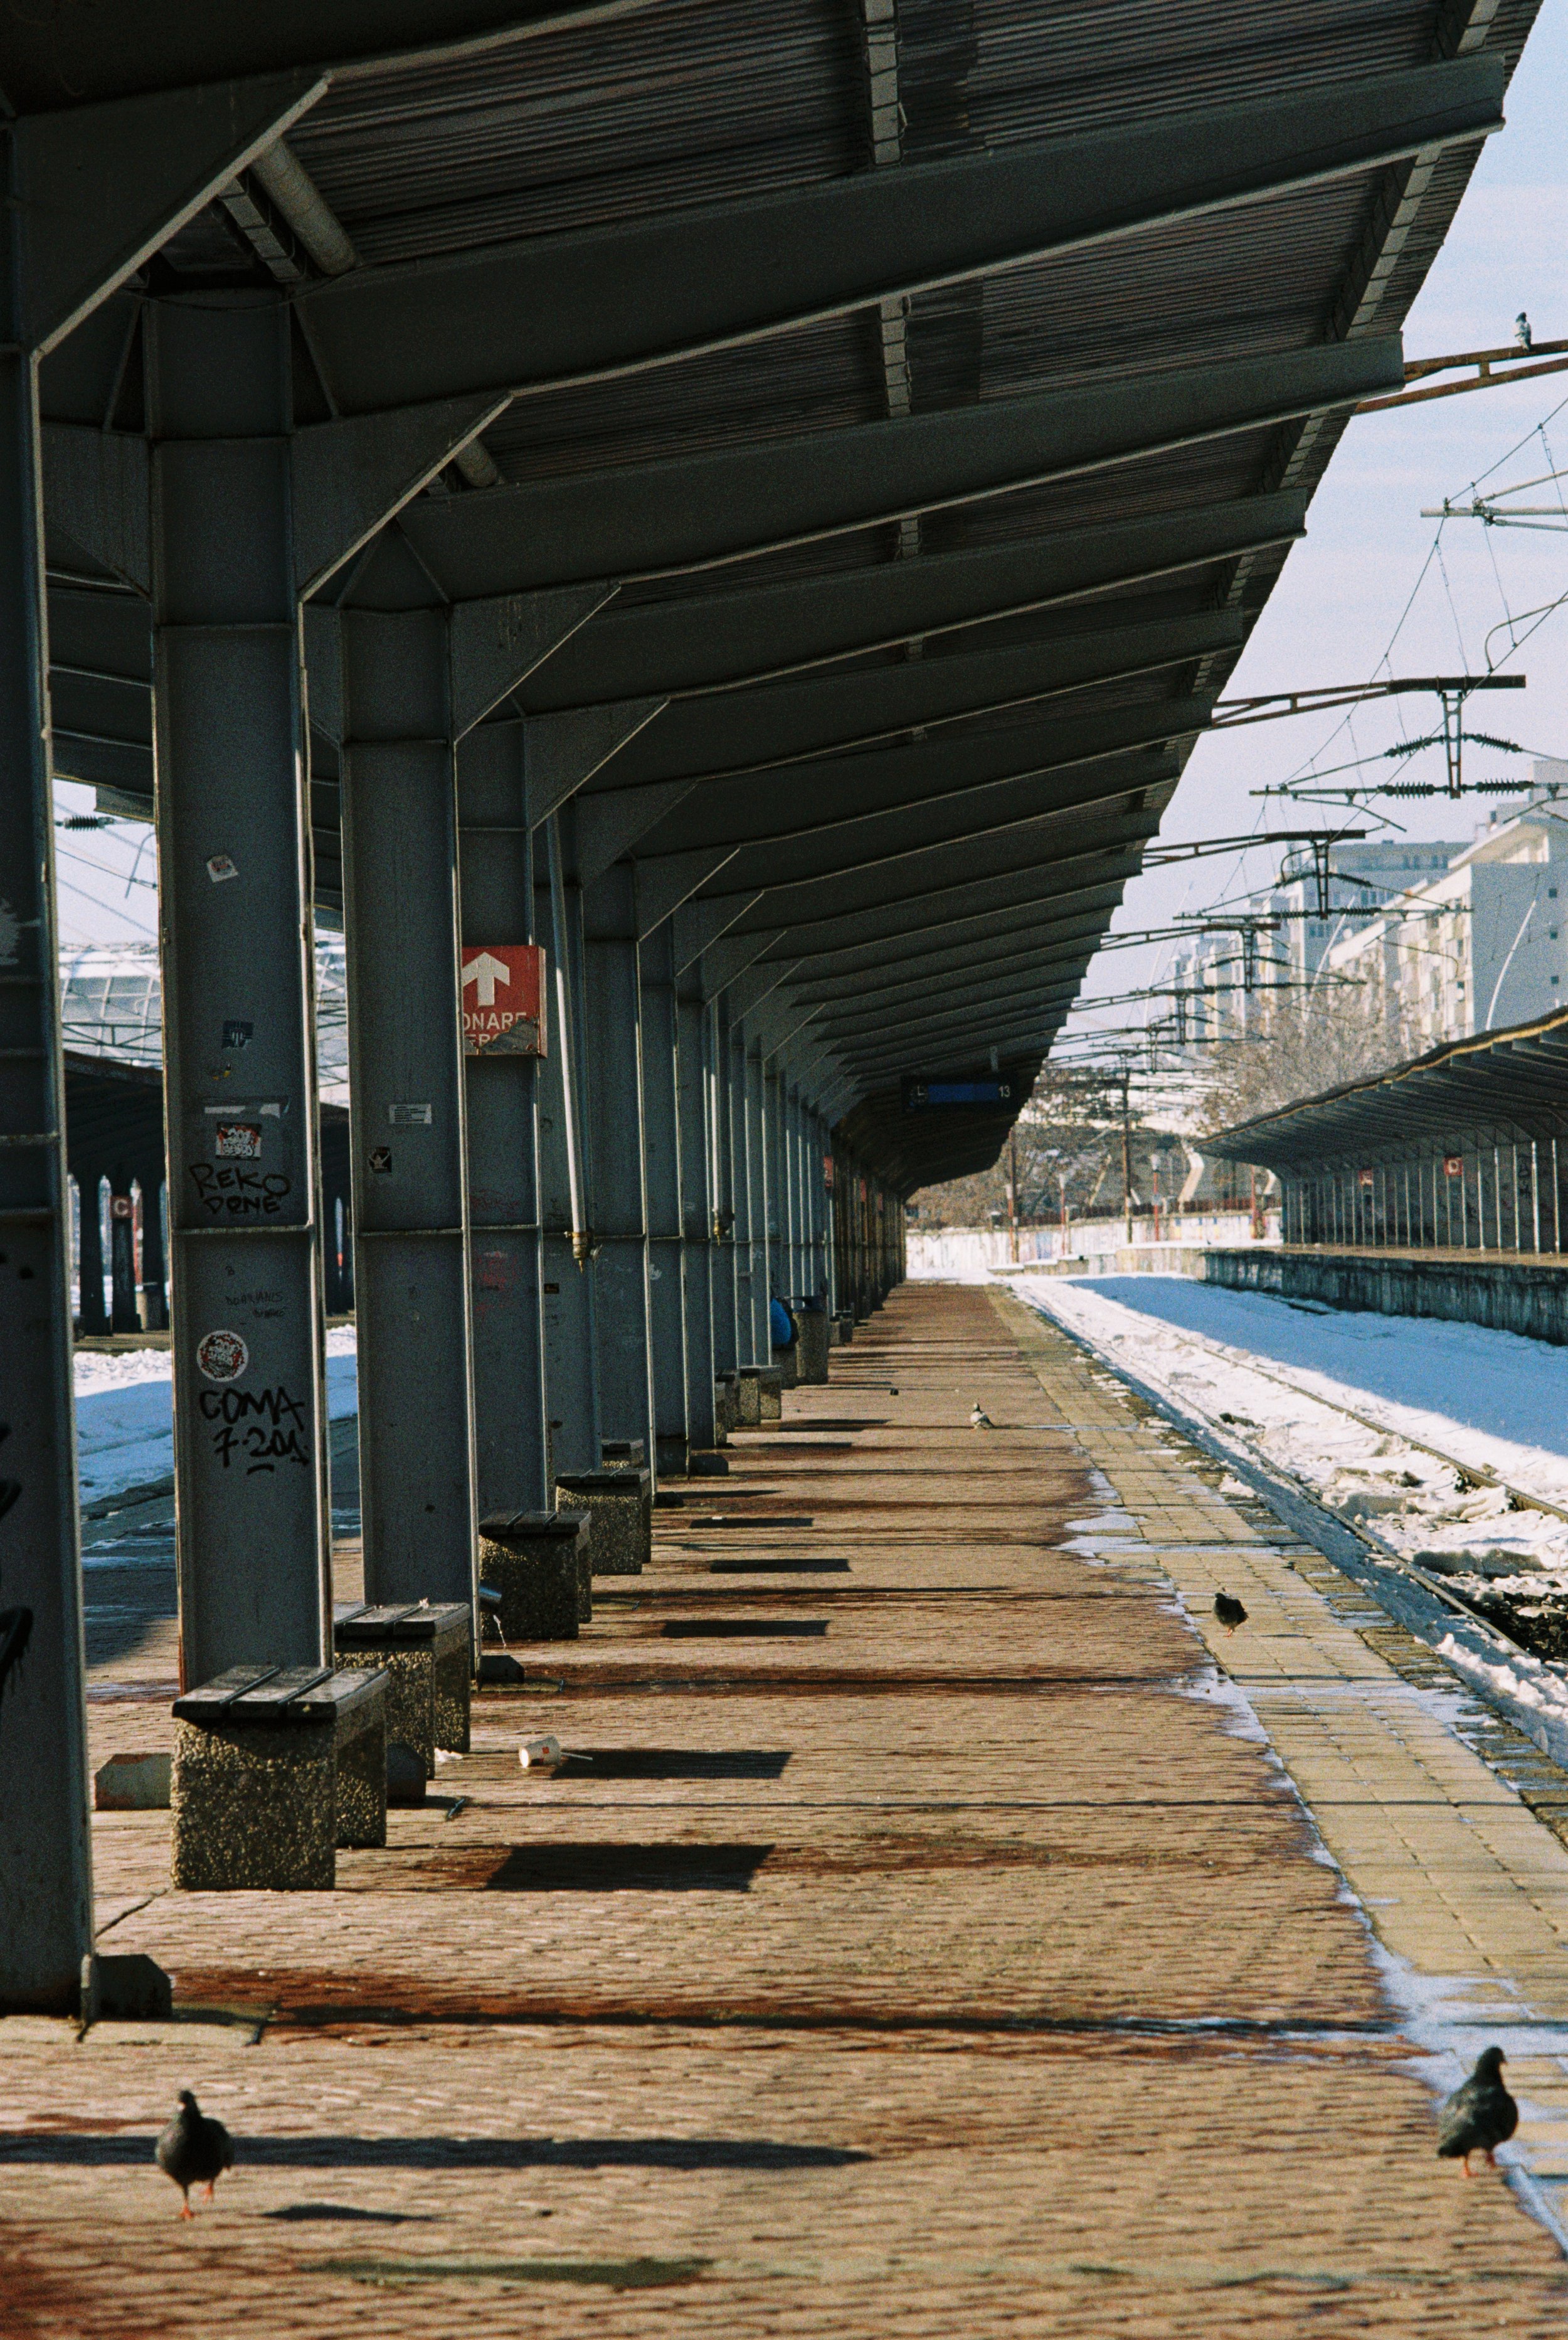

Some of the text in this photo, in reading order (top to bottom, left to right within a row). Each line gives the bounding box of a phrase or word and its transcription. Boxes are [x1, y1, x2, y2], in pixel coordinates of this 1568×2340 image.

[999, 1085, 1010, 1097] 13
[189, 1162, 292, 1198] REKO
[114, 1199, 129, 1216] C
[199, 1386, 305, 1432] COMA
